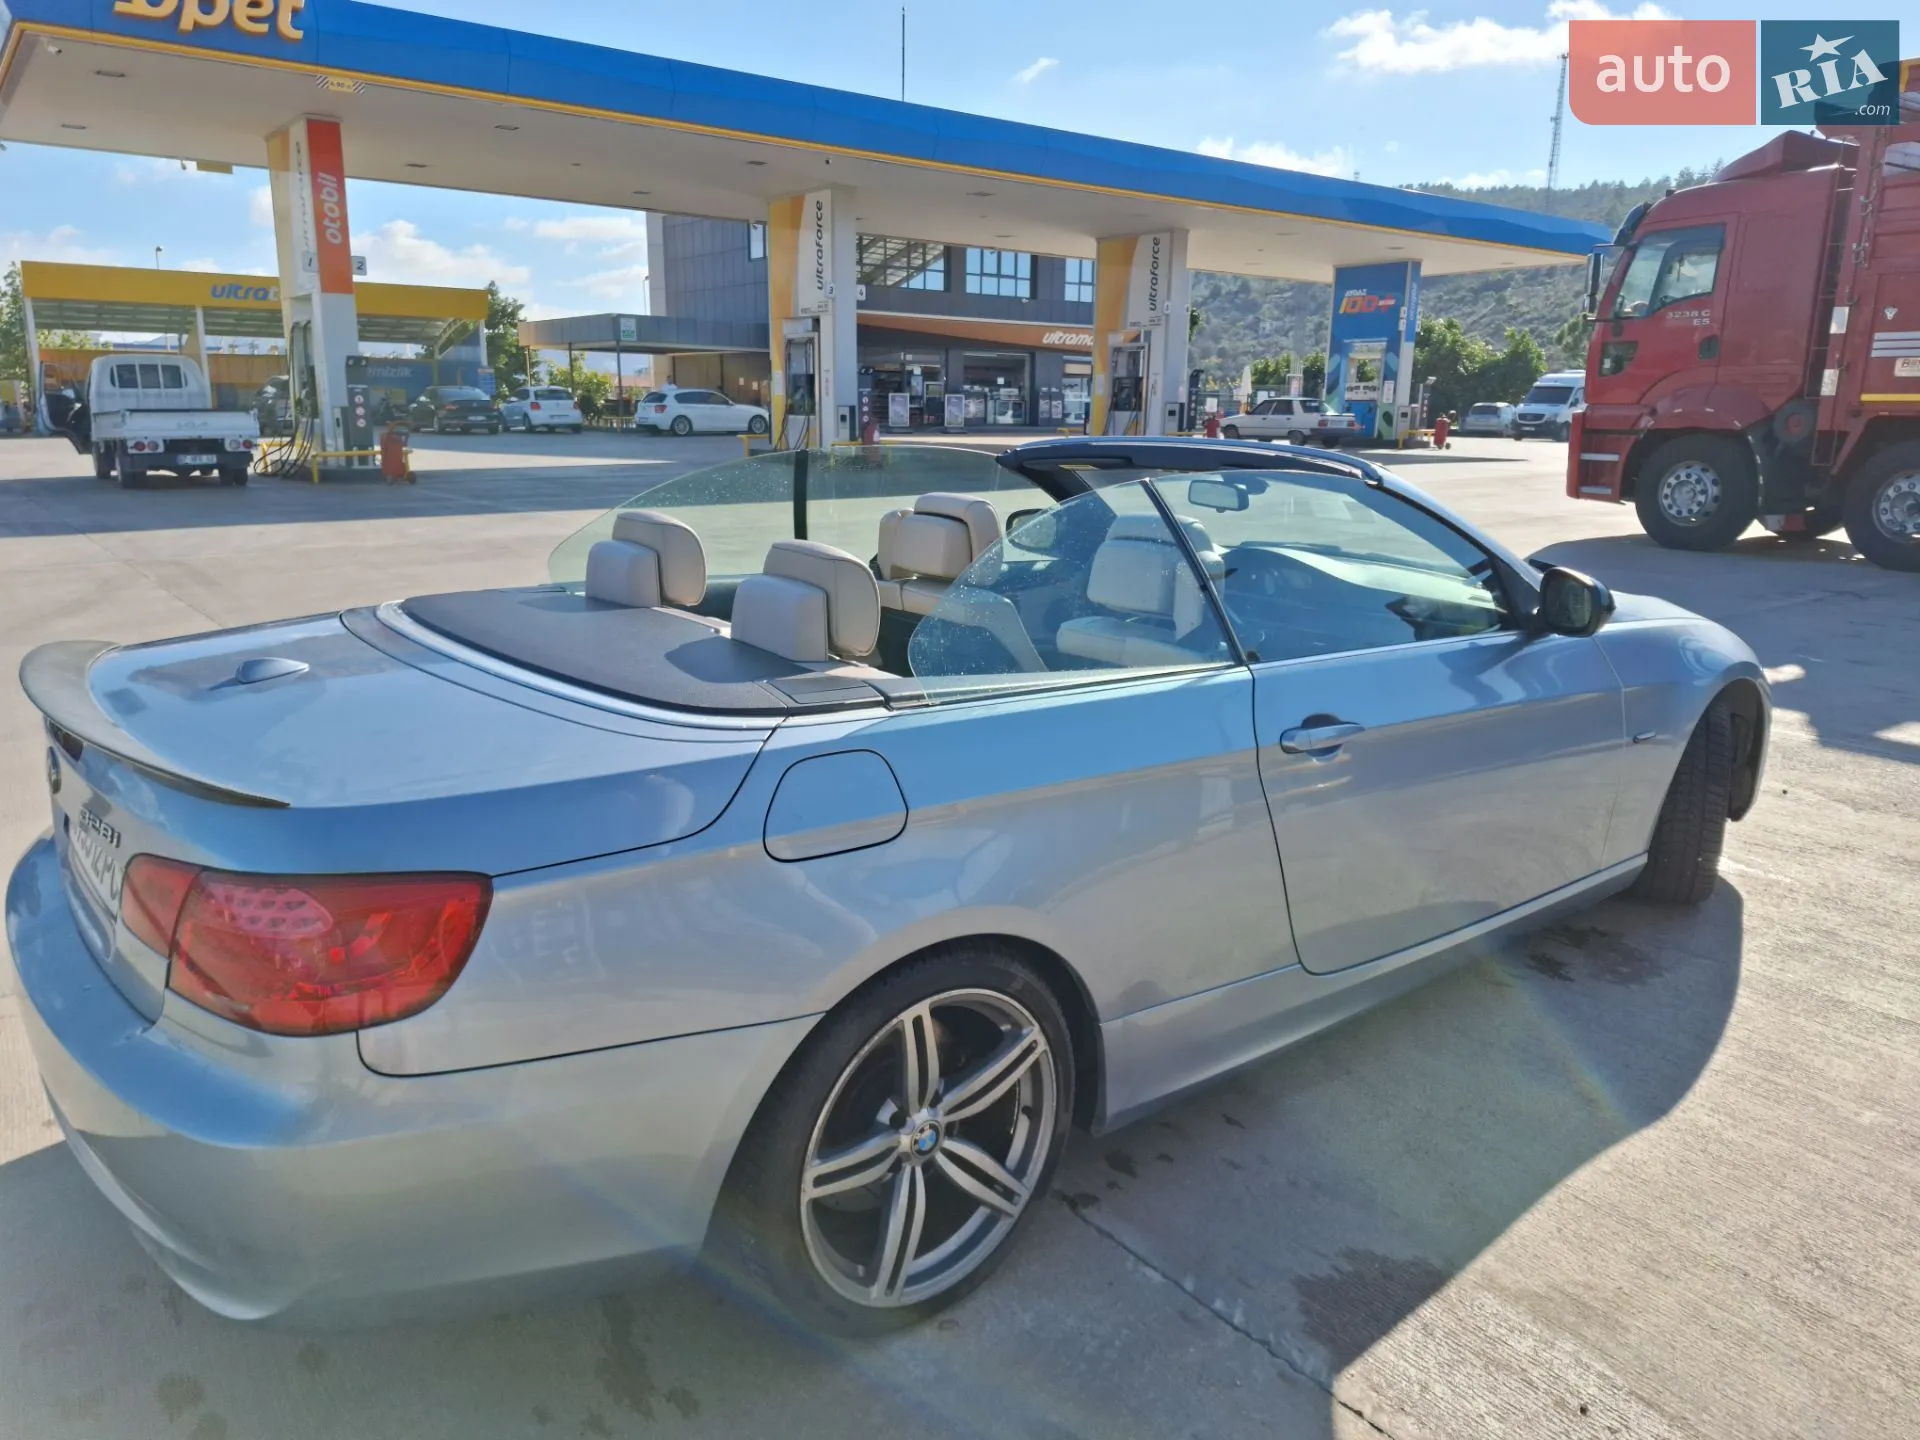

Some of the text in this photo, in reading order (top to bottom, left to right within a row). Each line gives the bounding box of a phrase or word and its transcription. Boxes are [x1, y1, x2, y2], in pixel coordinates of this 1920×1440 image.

[318, 171, 342, 245] otobil
[815, 200, 824, 291] ultraforce
[356, 260, 364, 270] 2
[1149, 236, 1160, 312] ultraforce
